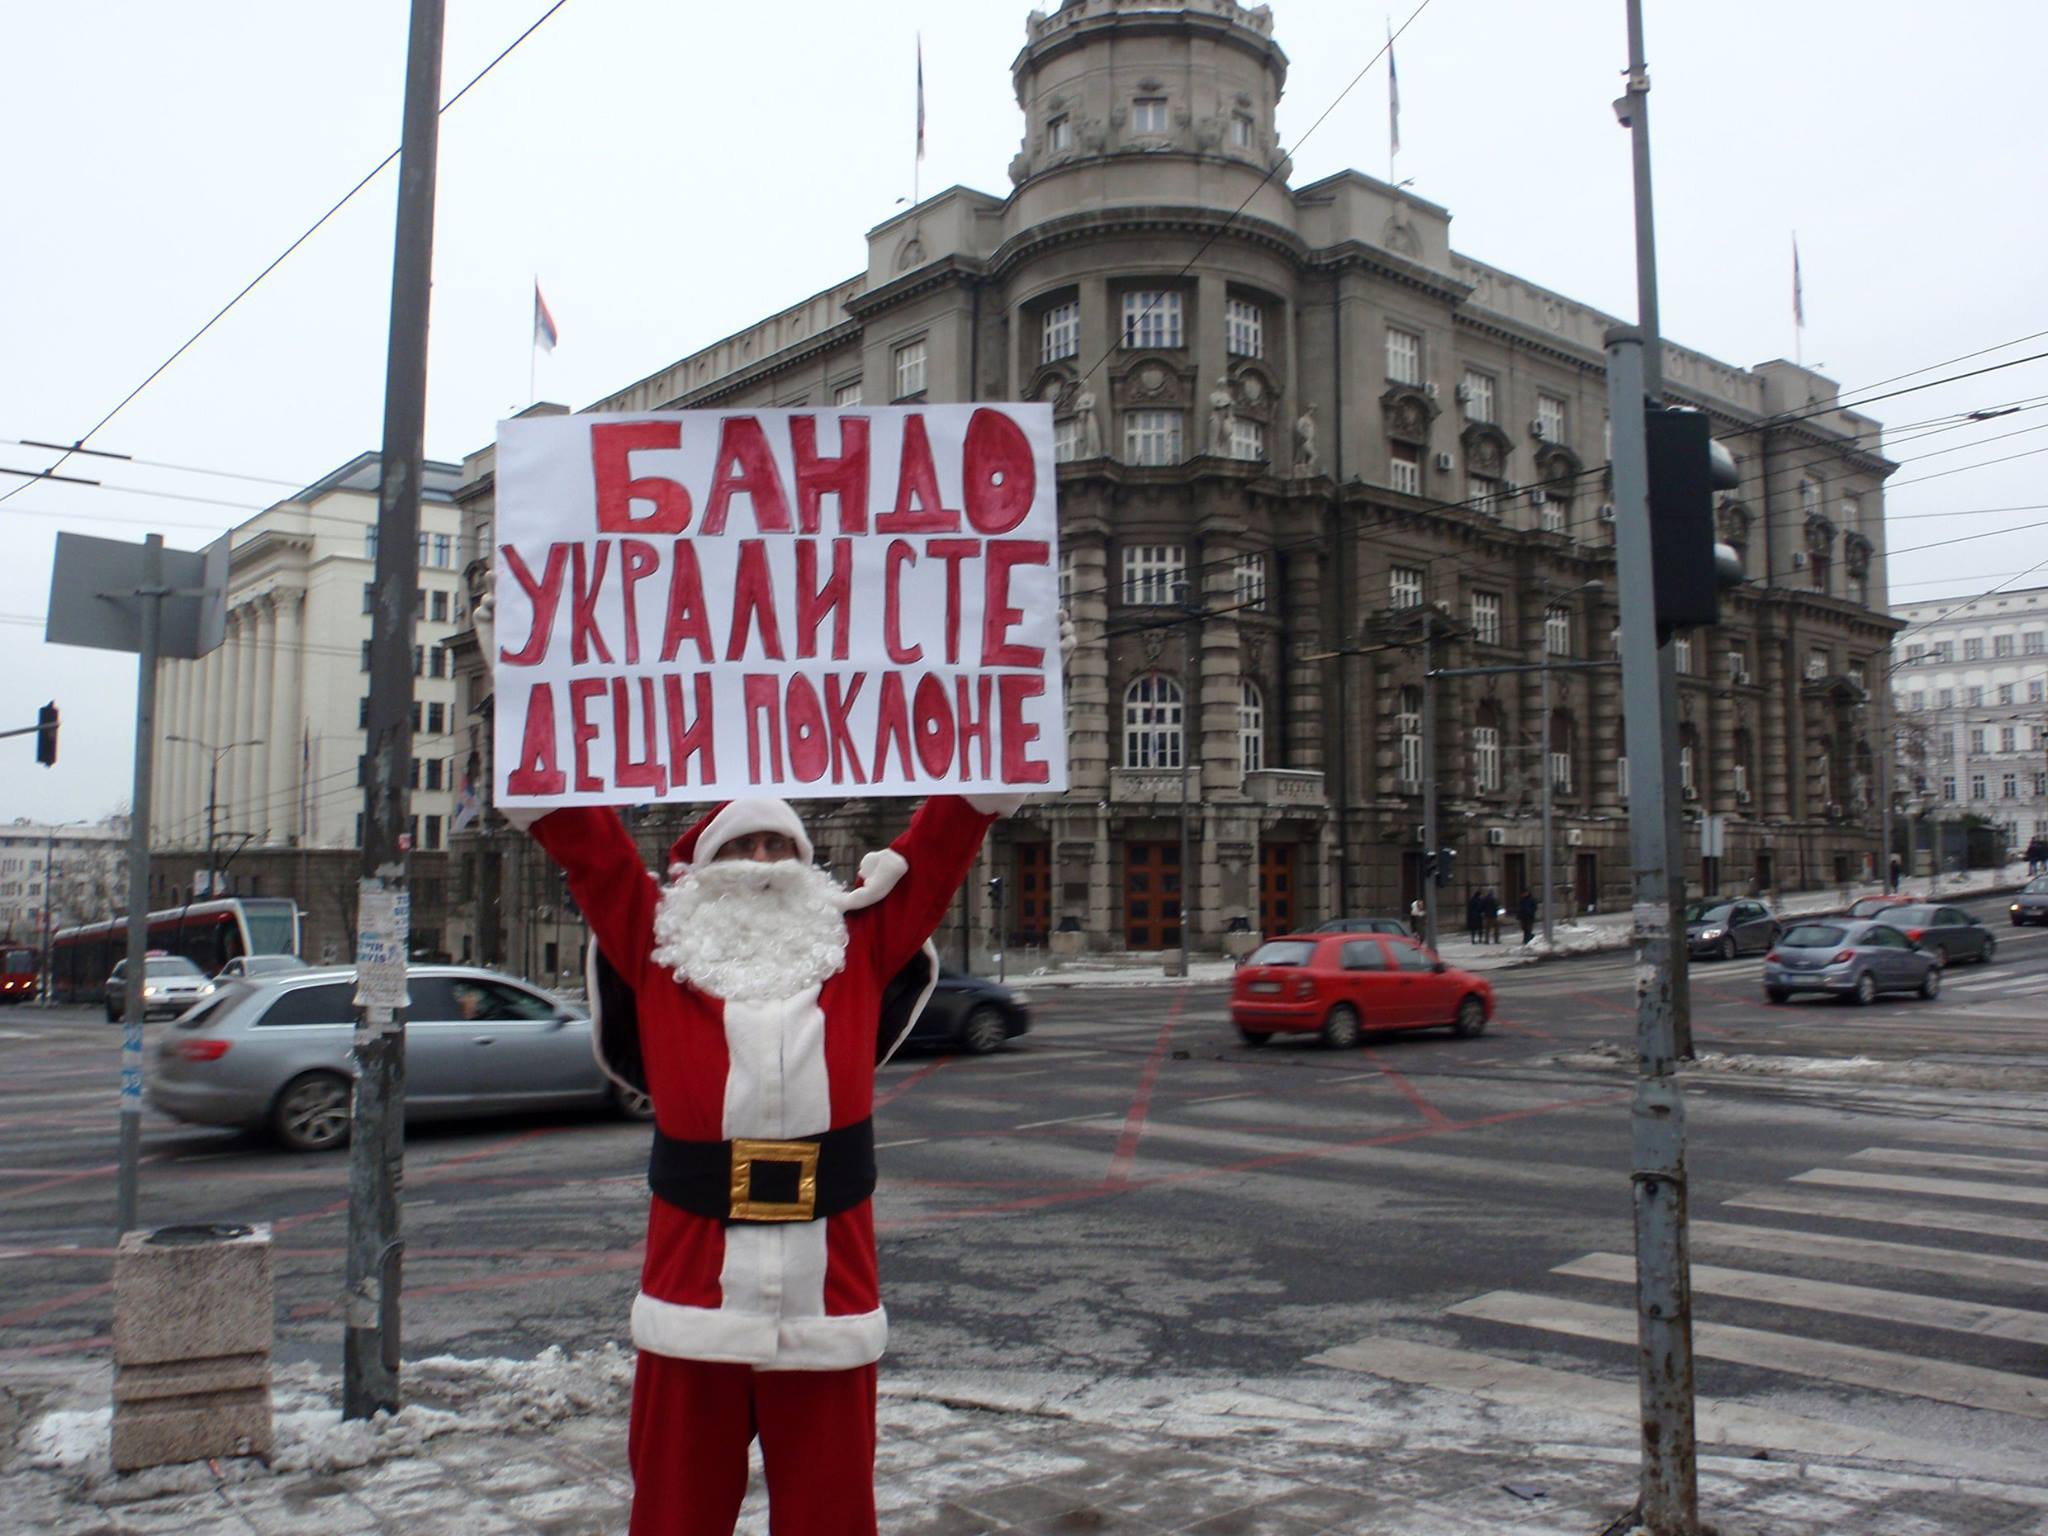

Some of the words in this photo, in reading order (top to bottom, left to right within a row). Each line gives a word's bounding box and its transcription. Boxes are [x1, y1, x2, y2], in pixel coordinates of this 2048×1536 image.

[591, 408, 1036, 535] БАНДО
[500, 538, 853, 666] УКРАЛИ
[884, 538, 1050, 668] СТЕ
[507, 671, 717, 797] ДЕЦИ
[743, 671, 1050, 784] ПОКЛОНЕ
